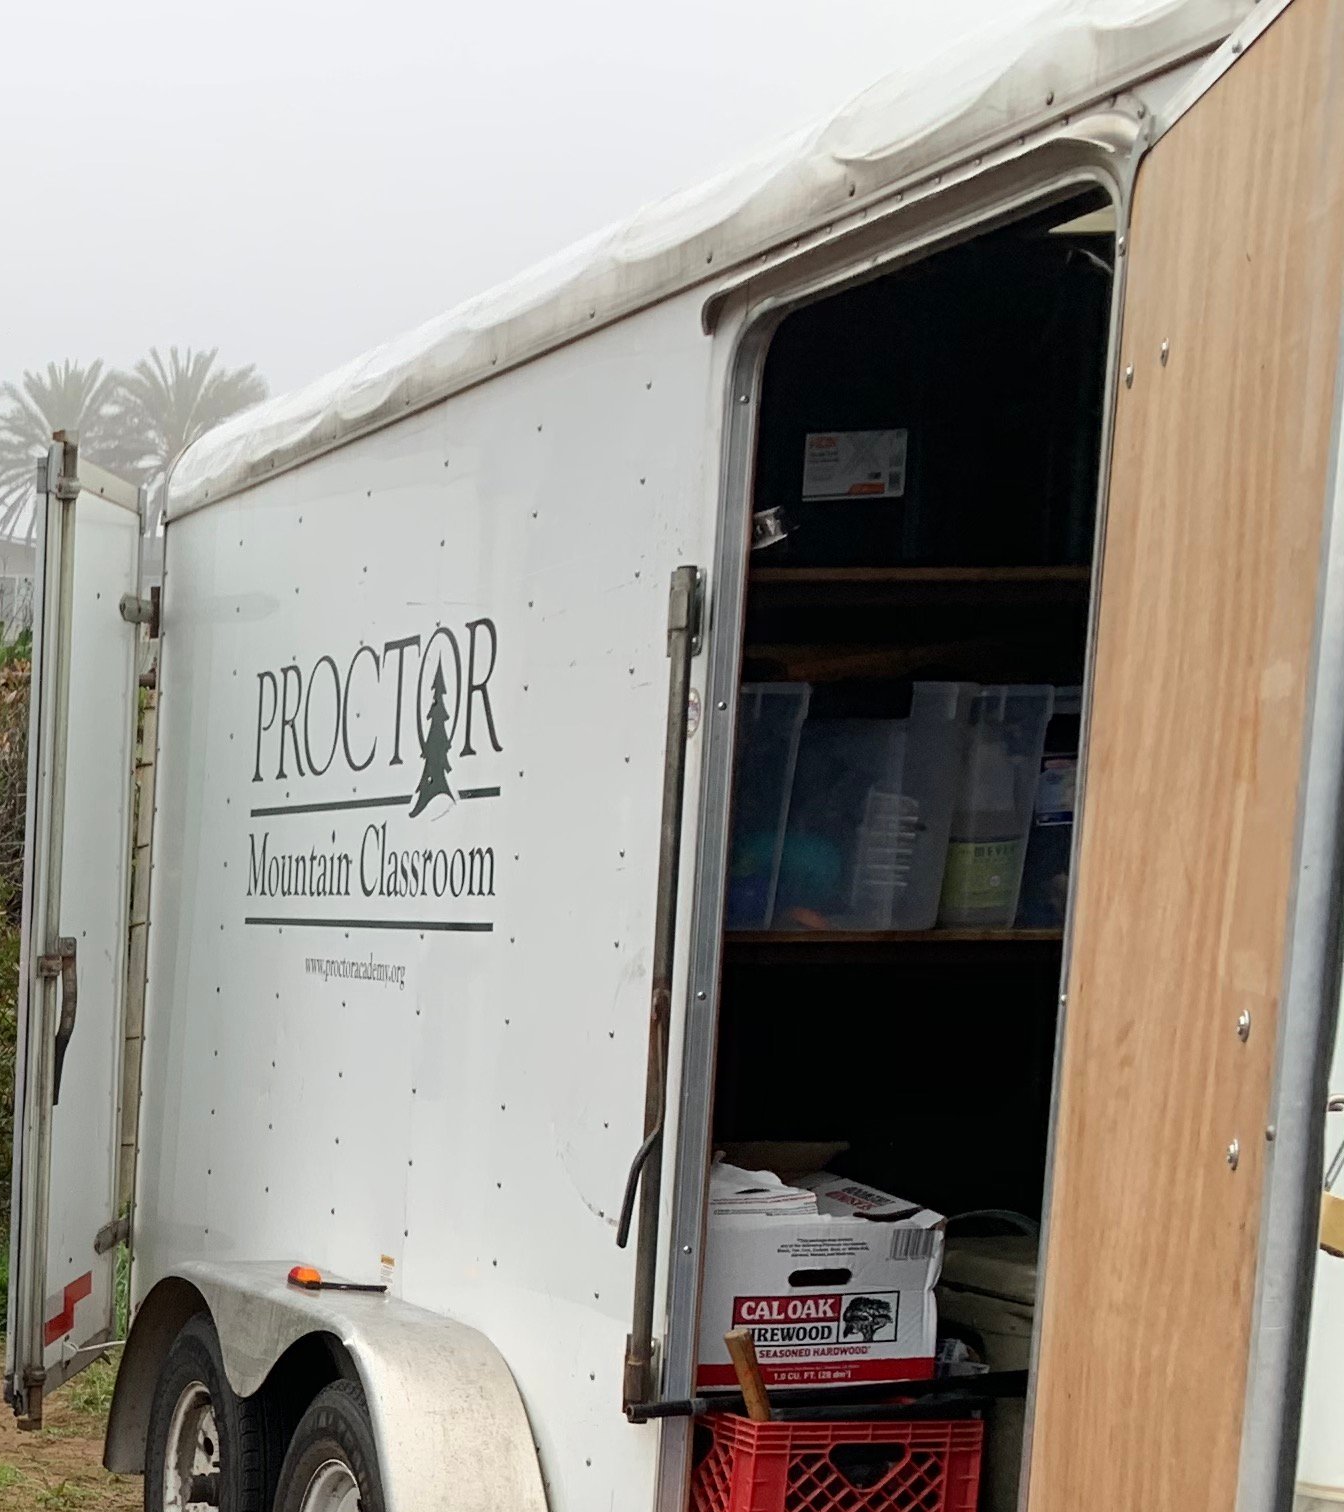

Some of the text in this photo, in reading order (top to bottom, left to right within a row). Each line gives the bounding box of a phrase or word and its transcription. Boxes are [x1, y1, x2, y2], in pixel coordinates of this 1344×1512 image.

[252, 617, 503, 783] PROCTOR
[246, 821, 496, 897] Mountain Classroom
[305, 954, 406, 990] www.proctoracademy.org
[741, 1299, 835, 1321] CAL OAK
[751, 1325, 832, 1343] IREWOOD
[759, 1348, 811, 1359] SEASONED
